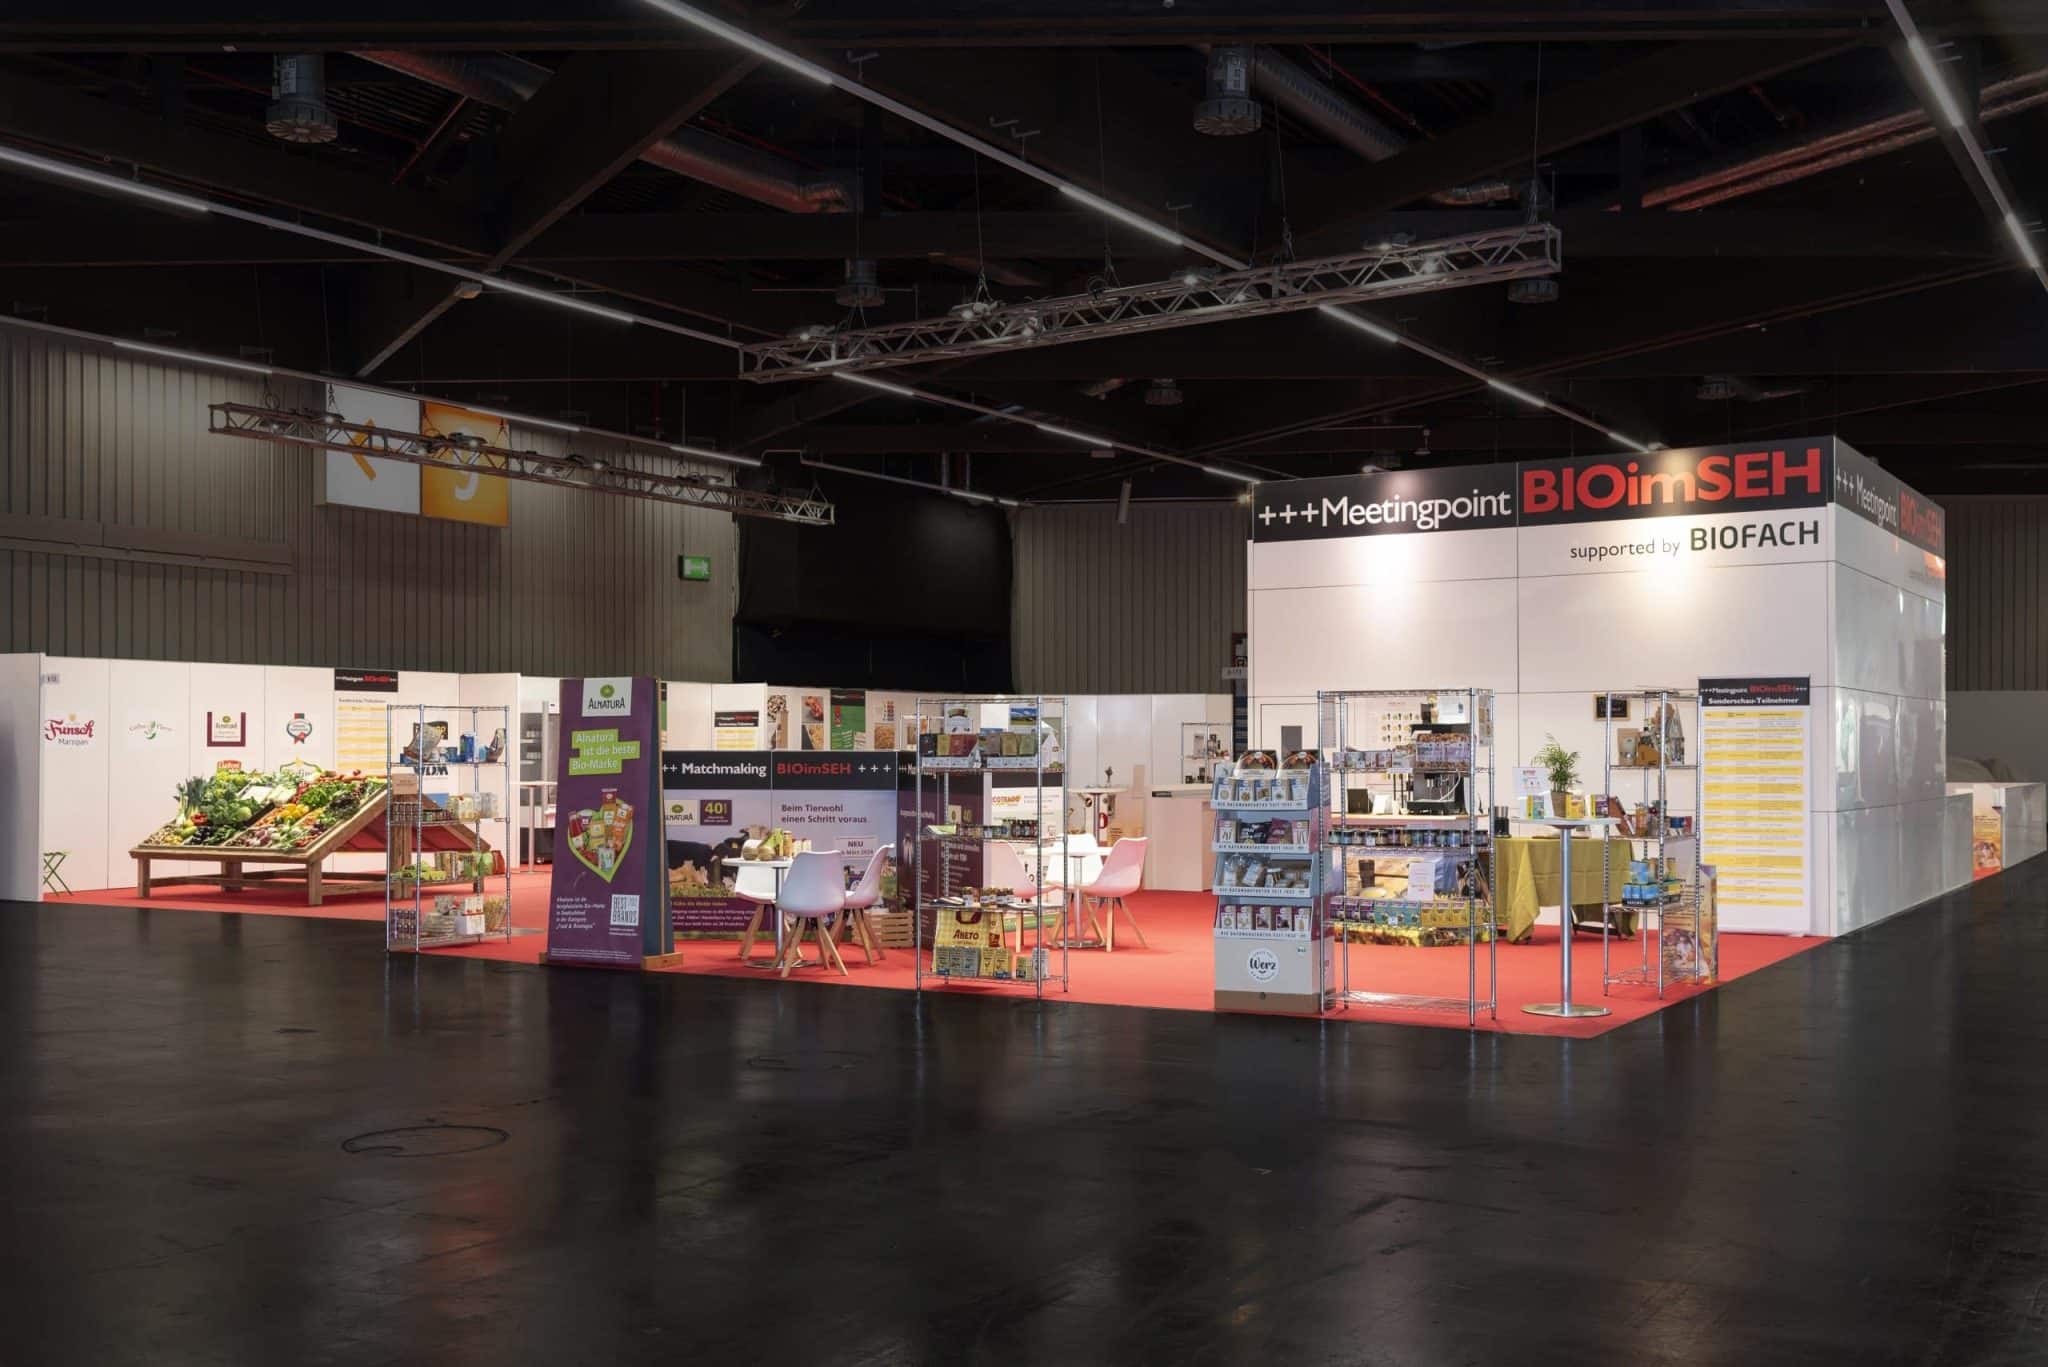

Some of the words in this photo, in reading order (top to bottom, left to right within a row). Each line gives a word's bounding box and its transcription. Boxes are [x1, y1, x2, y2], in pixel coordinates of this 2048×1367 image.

[1523, 448, 1821, 513] BIOimSEH
[1570, 540, 1655, 563] supported
[1662, 538, 1681, 558] by
[1690, 520, 1820, 551] BIOFACH
[588, 697, 626, 710] ALNATURA
[44, 719, 95, 741] Funsch
[577, 733, 614, 743] Alnatura
[681, 763, 767, 777] Matchmaking
[776, 763, 852, 775] BIOimSEH
[704, 802, 723, 815] 40
[781, 804, 803, 812] Beim
[806, 804, 844, 812] Tierwohl
[781, 815, 806, 823] einen
[808, 815, 836, 823] Schritt
[953, 929, 979, 940] ANETO
[1250, 957, 1276, 971] Werz
